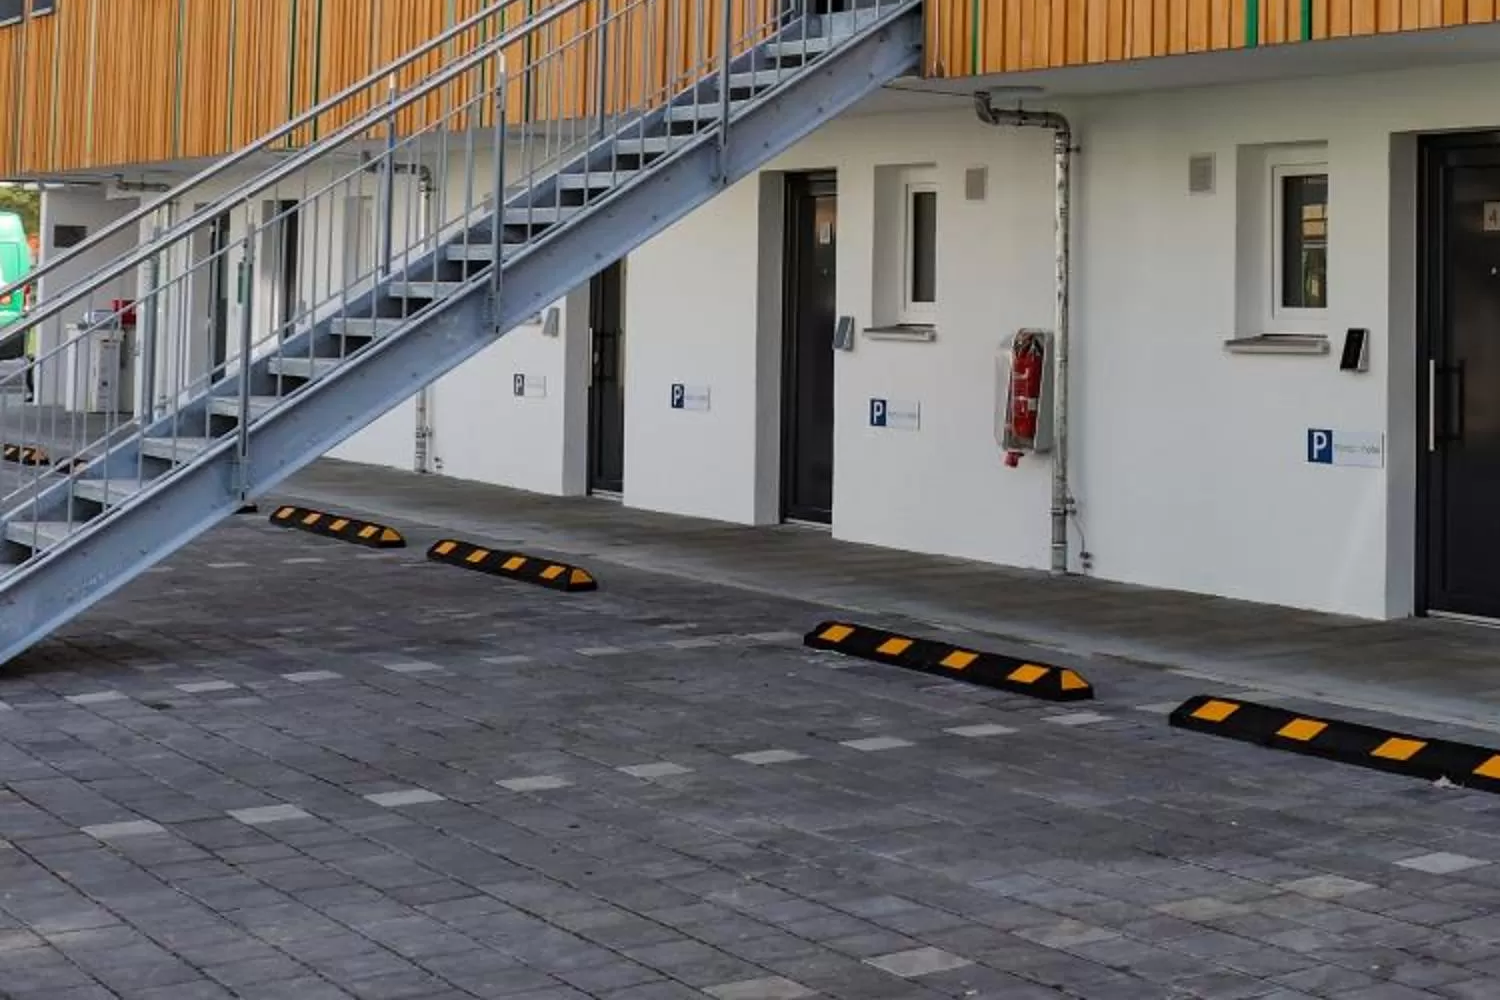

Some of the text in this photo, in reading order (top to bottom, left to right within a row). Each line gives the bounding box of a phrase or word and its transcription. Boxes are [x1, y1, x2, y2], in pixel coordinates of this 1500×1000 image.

[1488, 209, 1497, 228] 4
[516, 375, 523, 393] P
[674, 385, 683, 407] P
[873, 401, 884, 425] P
[1313, 432, 1327, 460] P
